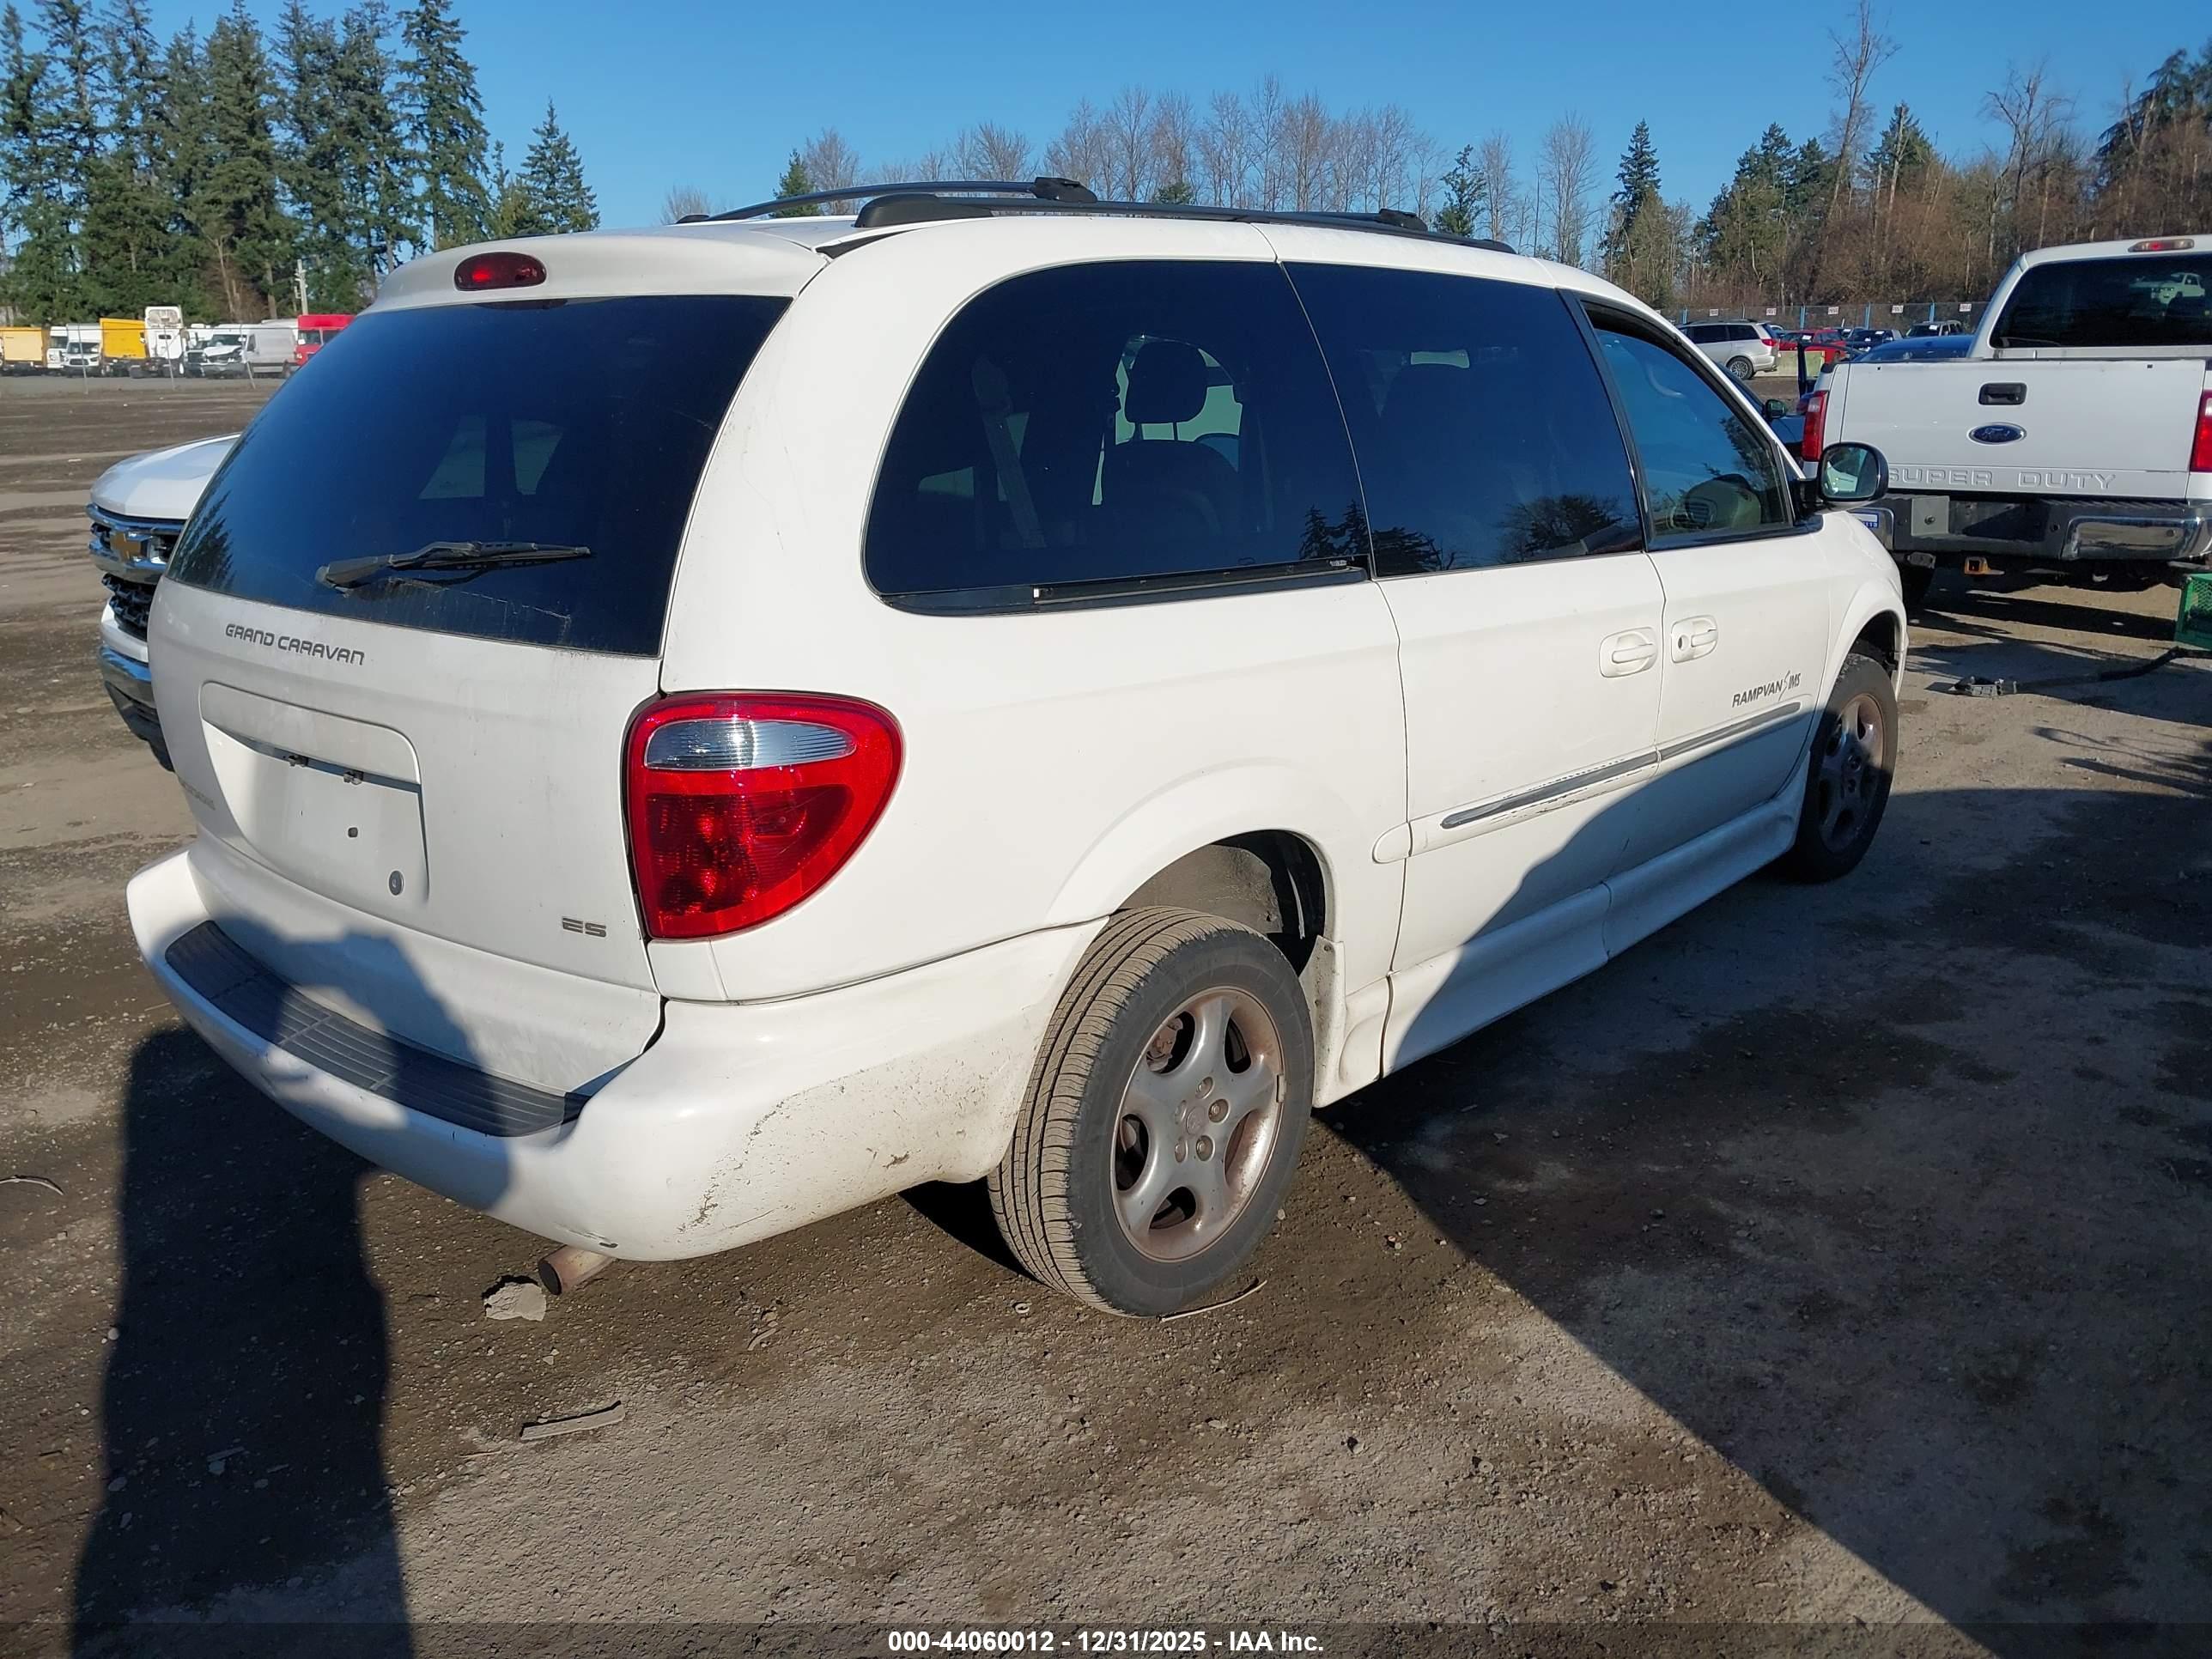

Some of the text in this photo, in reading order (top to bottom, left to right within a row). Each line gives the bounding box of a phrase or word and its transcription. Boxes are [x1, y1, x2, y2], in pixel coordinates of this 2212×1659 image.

[2018, 471, 2116, 489] DUTY
[226, 623, 365, 665] GRAND CARAVAN
[1731, 678, 1784, 708] RAMPVAN
[562, 917, 607, 938] ES
